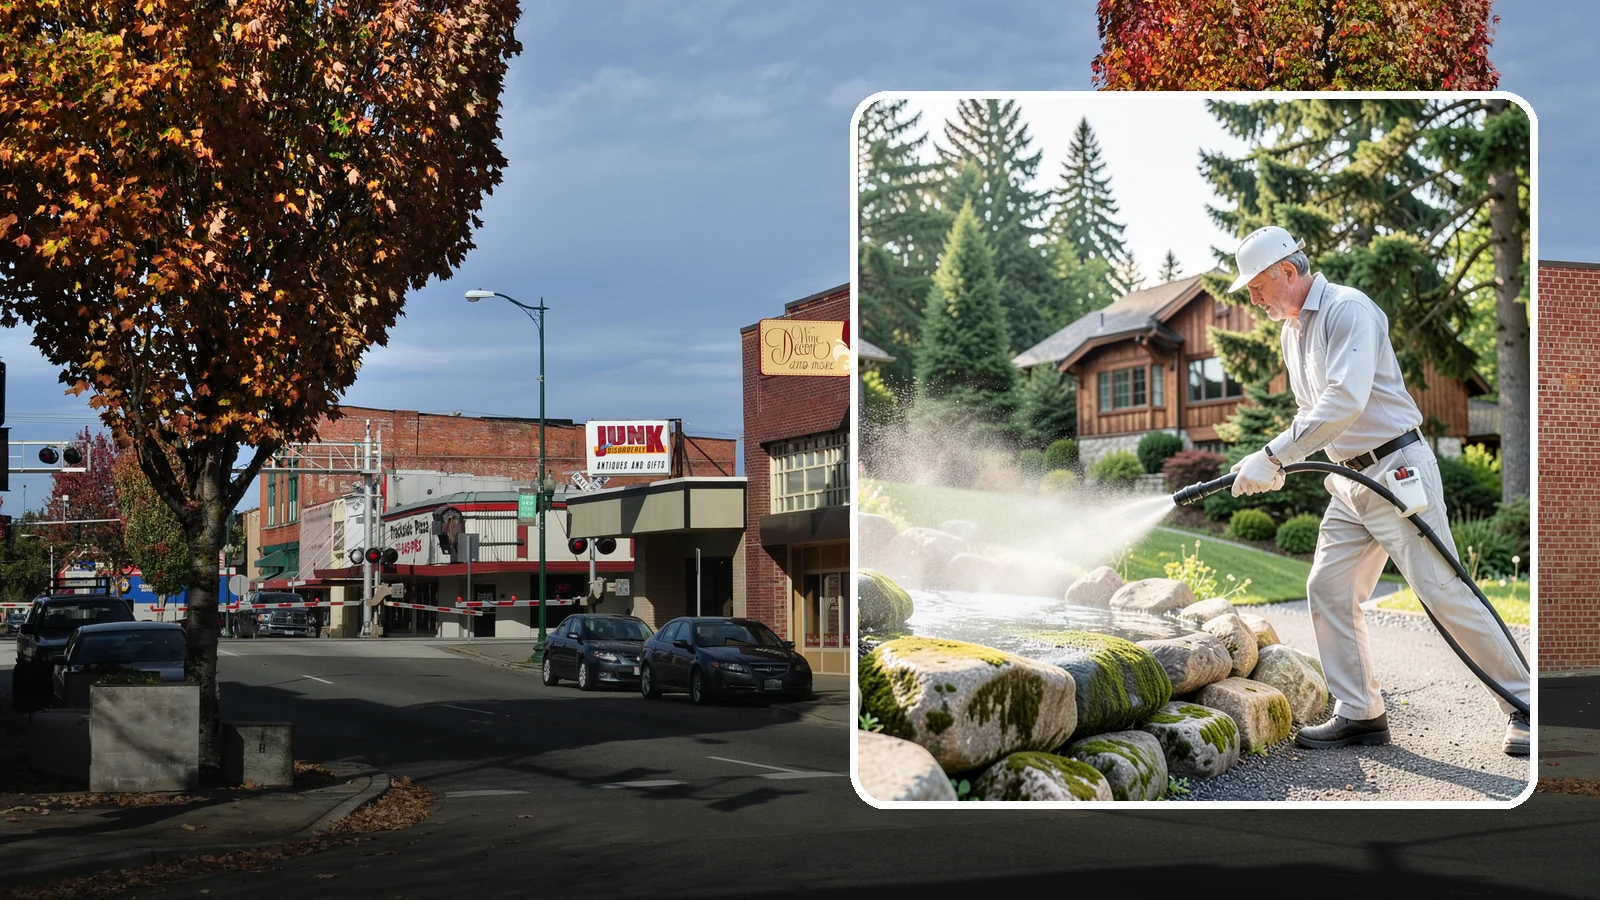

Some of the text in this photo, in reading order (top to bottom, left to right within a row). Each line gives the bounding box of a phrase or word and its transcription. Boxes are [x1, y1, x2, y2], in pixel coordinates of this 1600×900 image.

[595, 425, 665, 457] JUNK
[607, 446, 646, 454] DISORDERLY
[597, 460, 665, 470] ANTIQUES AND GIFTS
[573, 473, 588, 491] RAIL
[590, 476, 608, 492] SING
[352, 498, 365, 511] CRO
[414, 519, 429, 535] Pizza
